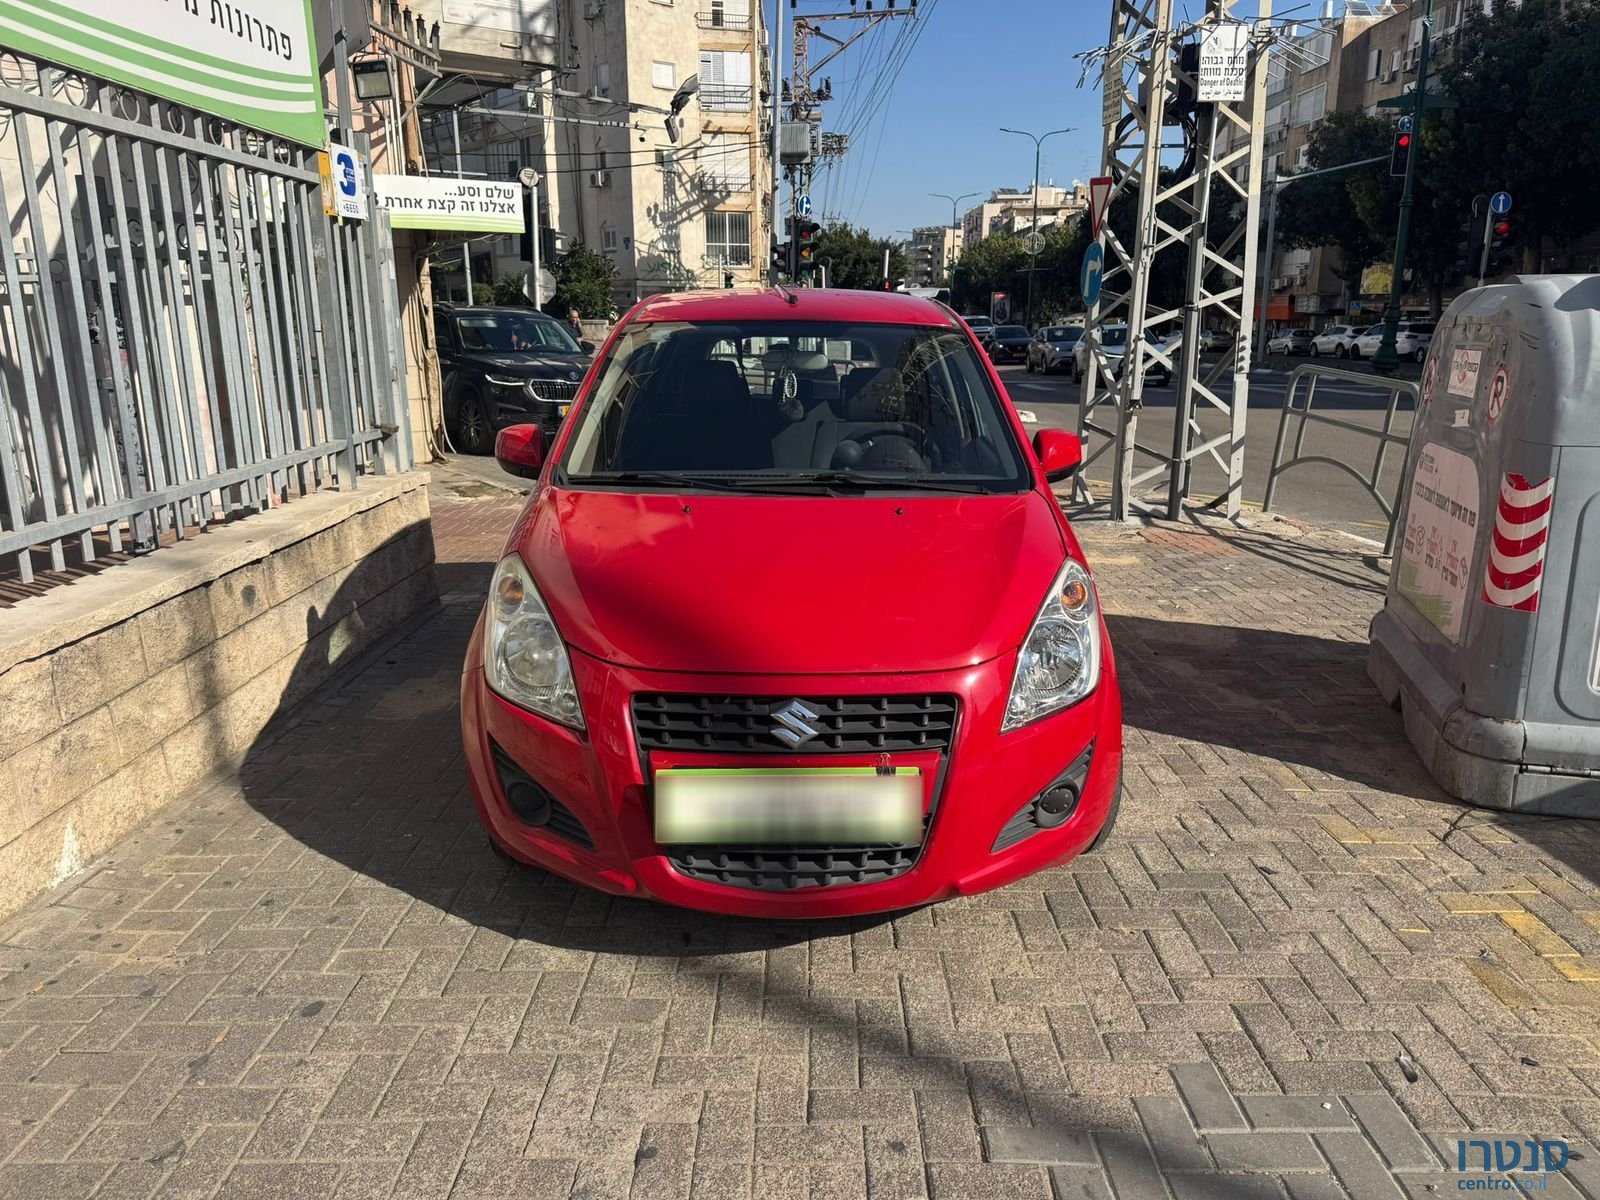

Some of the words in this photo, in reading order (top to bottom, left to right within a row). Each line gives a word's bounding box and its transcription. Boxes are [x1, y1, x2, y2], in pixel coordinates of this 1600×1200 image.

[210, 0, 292, 61] פתרונות
[1202, 56, 1223, 65] גבוה!
[1228, 56, 1244, 65] מתח
[1200, 67, 1221, 76] מוות!
[1224, 67, 1244, 76] סכנת
[1200, 78, 1219, 88] Danger
[1219, 77, 1226, 86] of
[1226, 77, 1244, 86] Death!
[444, 186, 481, 197] וסע...
[486, 186, 514, 200] שלם
[384, 196, 422, 209] אחרת
[427, 197, 456, 213] קצת
[461, 200, 475, 212] זה
[480, 200, 515, 214] אצלנו
